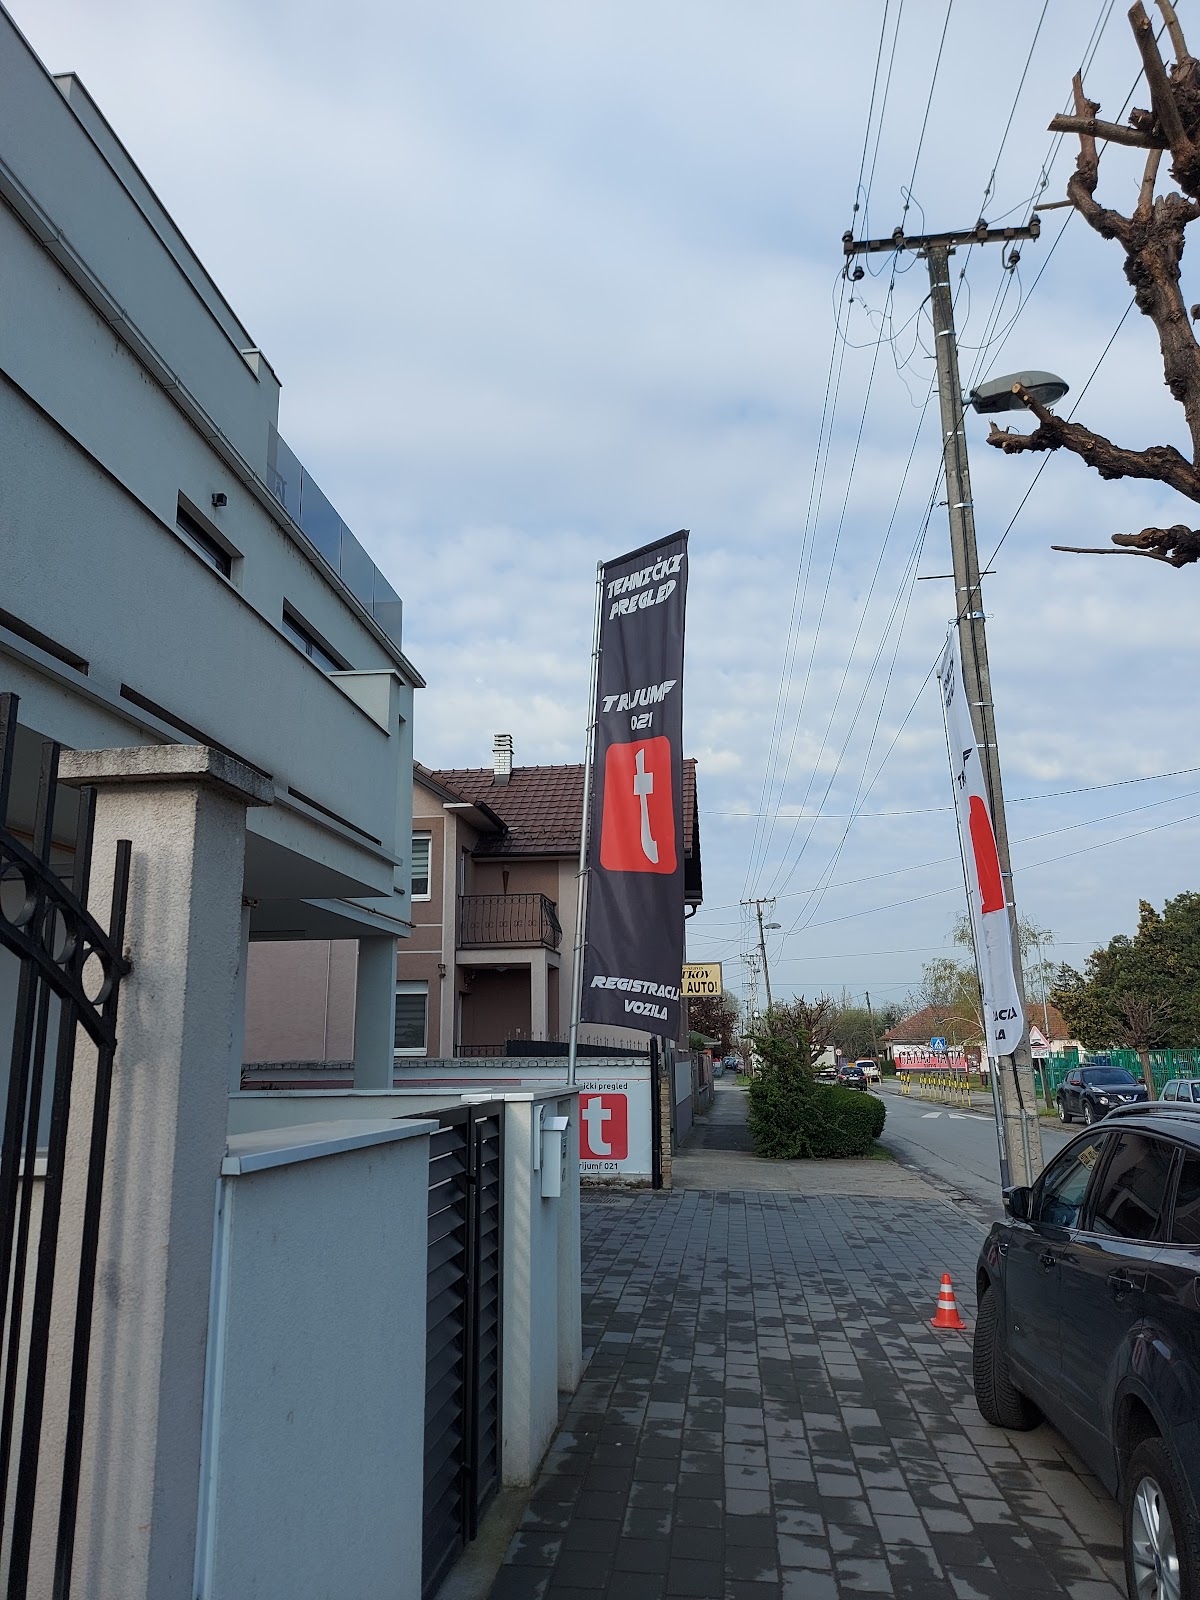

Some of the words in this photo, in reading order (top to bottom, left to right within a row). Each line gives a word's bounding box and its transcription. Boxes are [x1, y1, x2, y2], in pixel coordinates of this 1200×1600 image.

[607, 553, 685, 599] TEHNIČKI
[609, 579, 677, 621] PREGLED
[631, 712, 654, 731] 021
[682, 970, 712, 979] TKOV
[590, 975, 680, 1002] REGISTRACIJ
[687, 981, 718, 994] AUTO!
[624, 999, 668, 1021] VOZILA
[583, 1082, 597, 1090] ički
[598, 1082, 628, 1092] pregled
[579, 1161, 603, 1171] rijumf
[604, 1162, 618, 1170] 021
